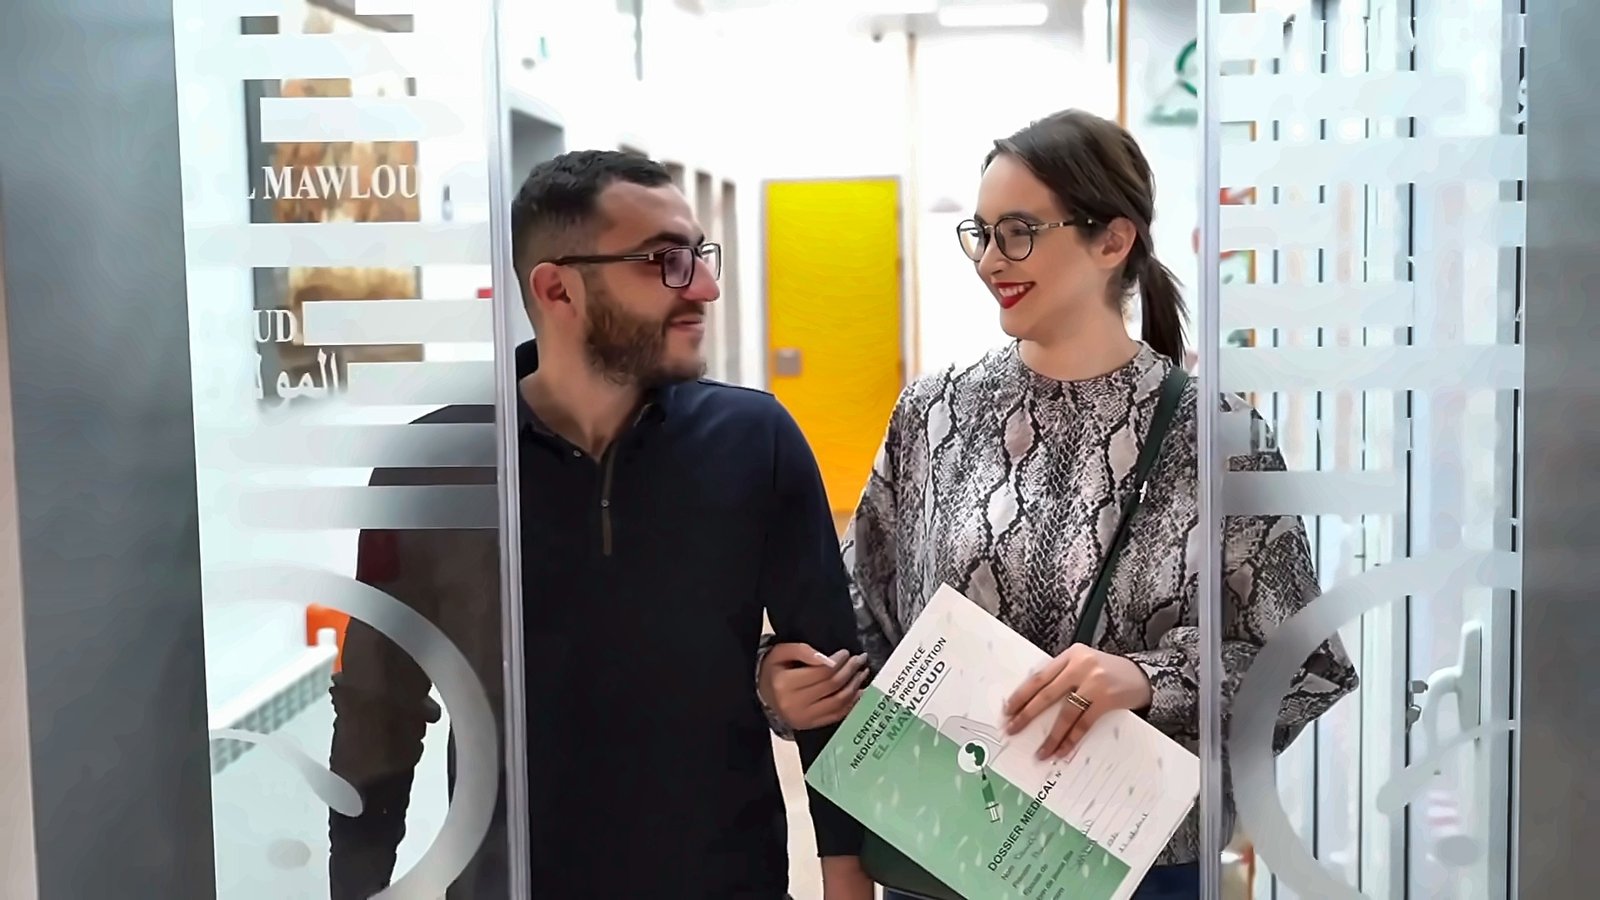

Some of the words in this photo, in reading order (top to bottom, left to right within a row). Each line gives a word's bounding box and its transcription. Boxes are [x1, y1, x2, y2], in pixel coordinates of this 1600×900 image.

[262, 165, 418, 200] MAWLOU
[850, 721, 887, 769] MEDICALE
[891, 702, 902, 715] LA
[899, 637, 947, 702] PROCREATION
[853, 709, 881, 745] CENTRE
[878, 646, 926, 712] D'ASSISTANCE
[872, 743, 889, 760] EL
[886, 661, 945, 741] MAWLOUD
[988, 825, 1024, 872] DOSSIER
[1020, 780, 1057, 826] MEDICAL
